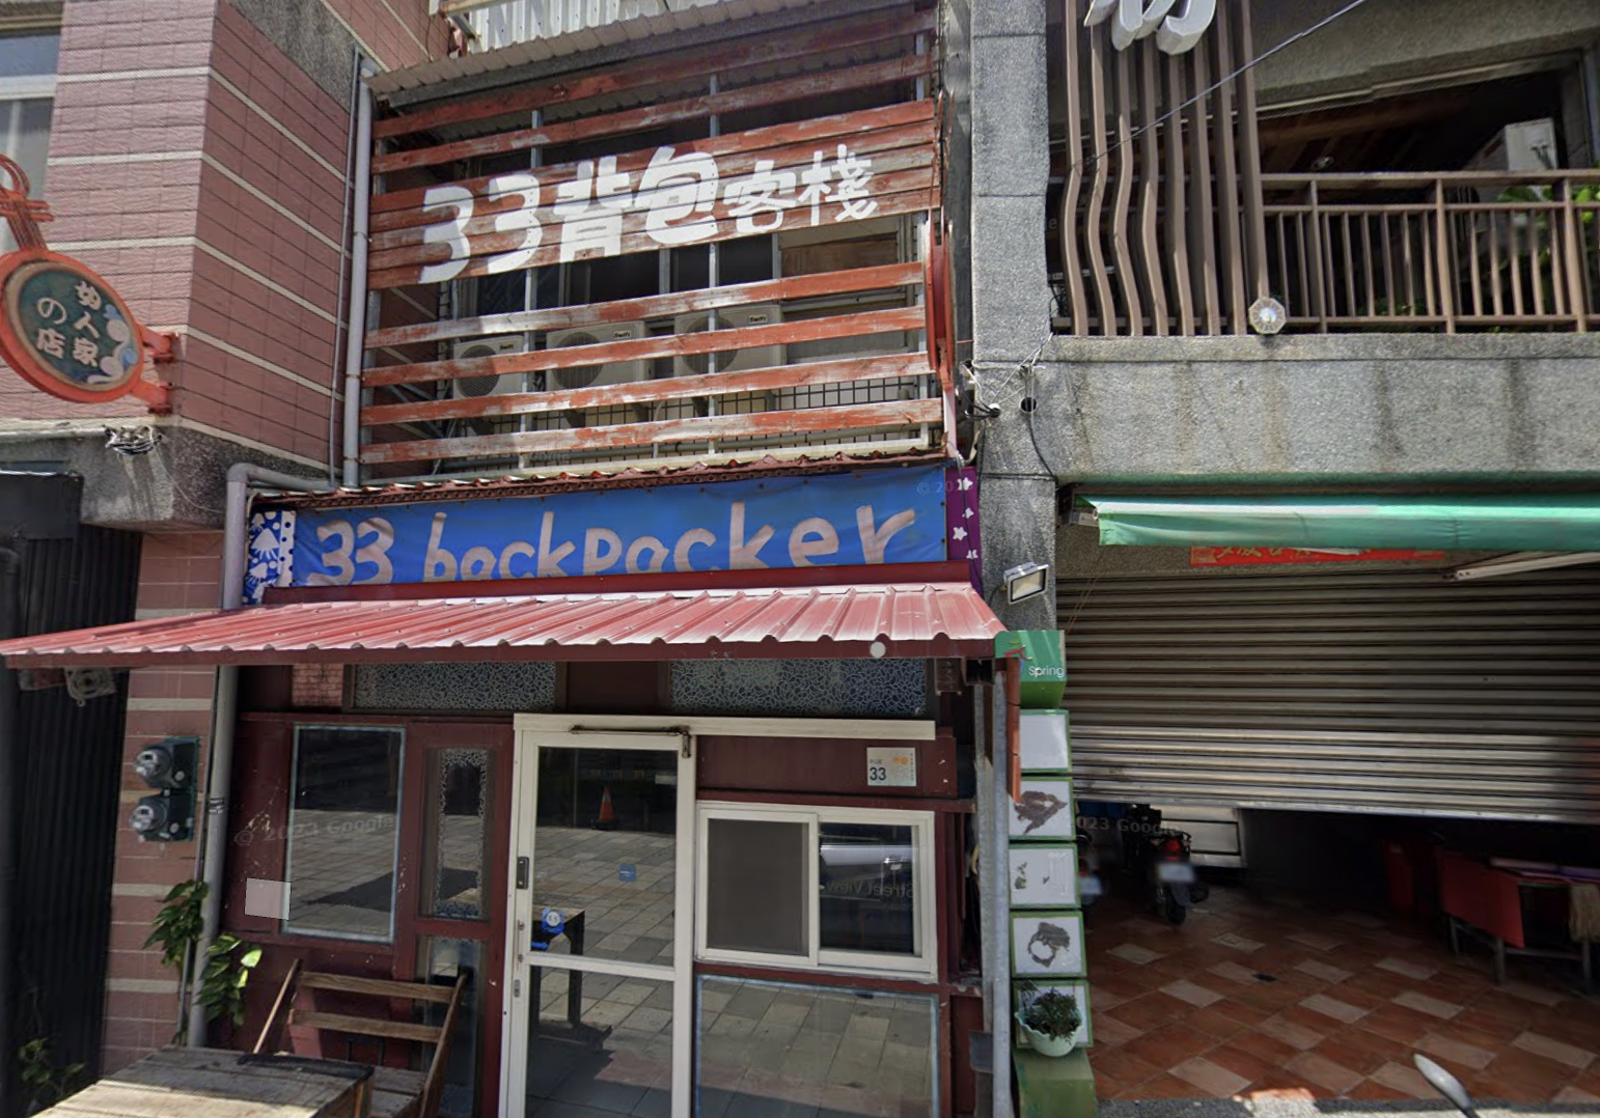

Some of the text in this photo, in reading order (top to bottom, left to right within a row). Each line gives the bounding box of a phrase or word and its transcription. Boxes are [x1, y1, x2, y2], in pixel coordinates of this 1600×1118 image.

[306, 517, 395, 586] 33
[1028, 665, 1065, 678] Spring
[869, 766, 887, 781] 33
